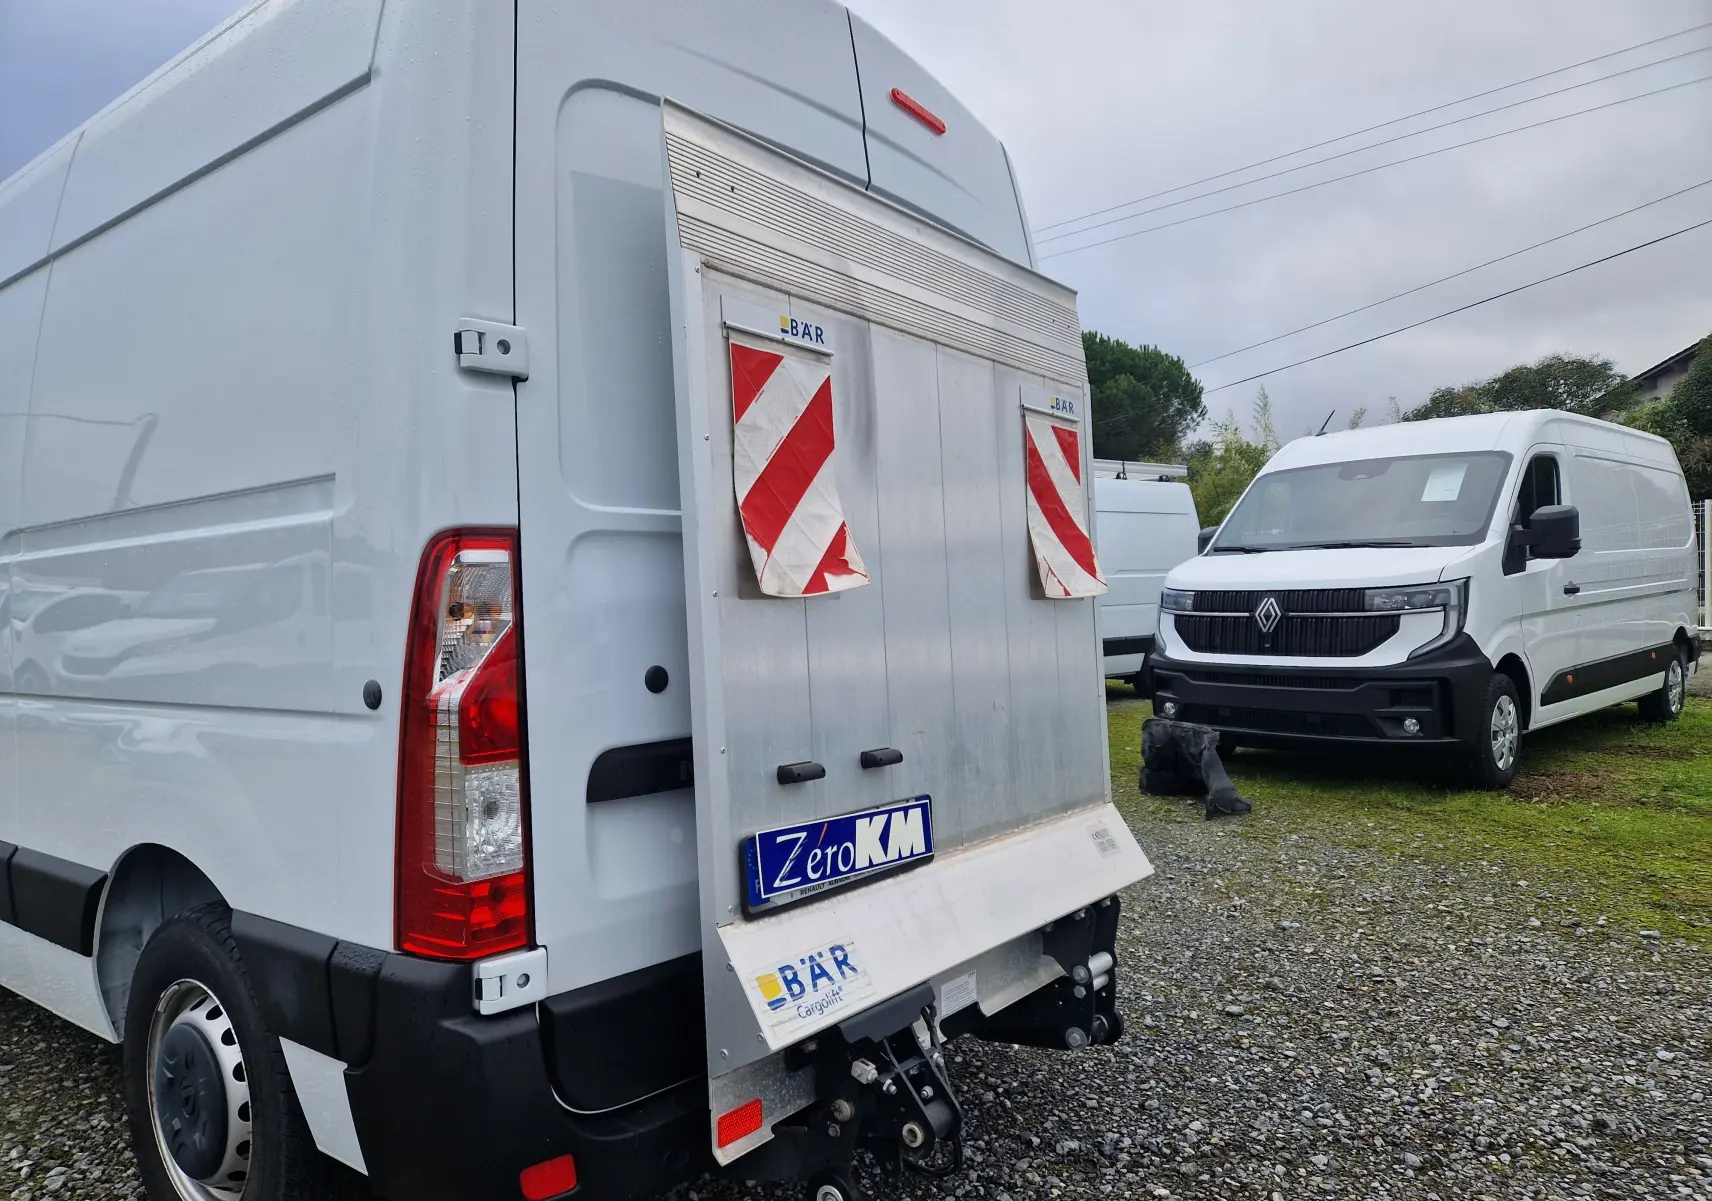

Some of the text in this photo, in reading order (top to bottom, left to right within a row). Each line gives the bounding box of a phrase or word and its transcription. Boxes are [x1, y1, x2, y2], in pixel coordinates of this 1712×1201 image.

[790, 318, 825, 345] BÄR
[1055, 397, 1075, 414] BÄR
[800, 882, 826, 896] RENAULT
[778, 944, 859, 1002] BÄR
